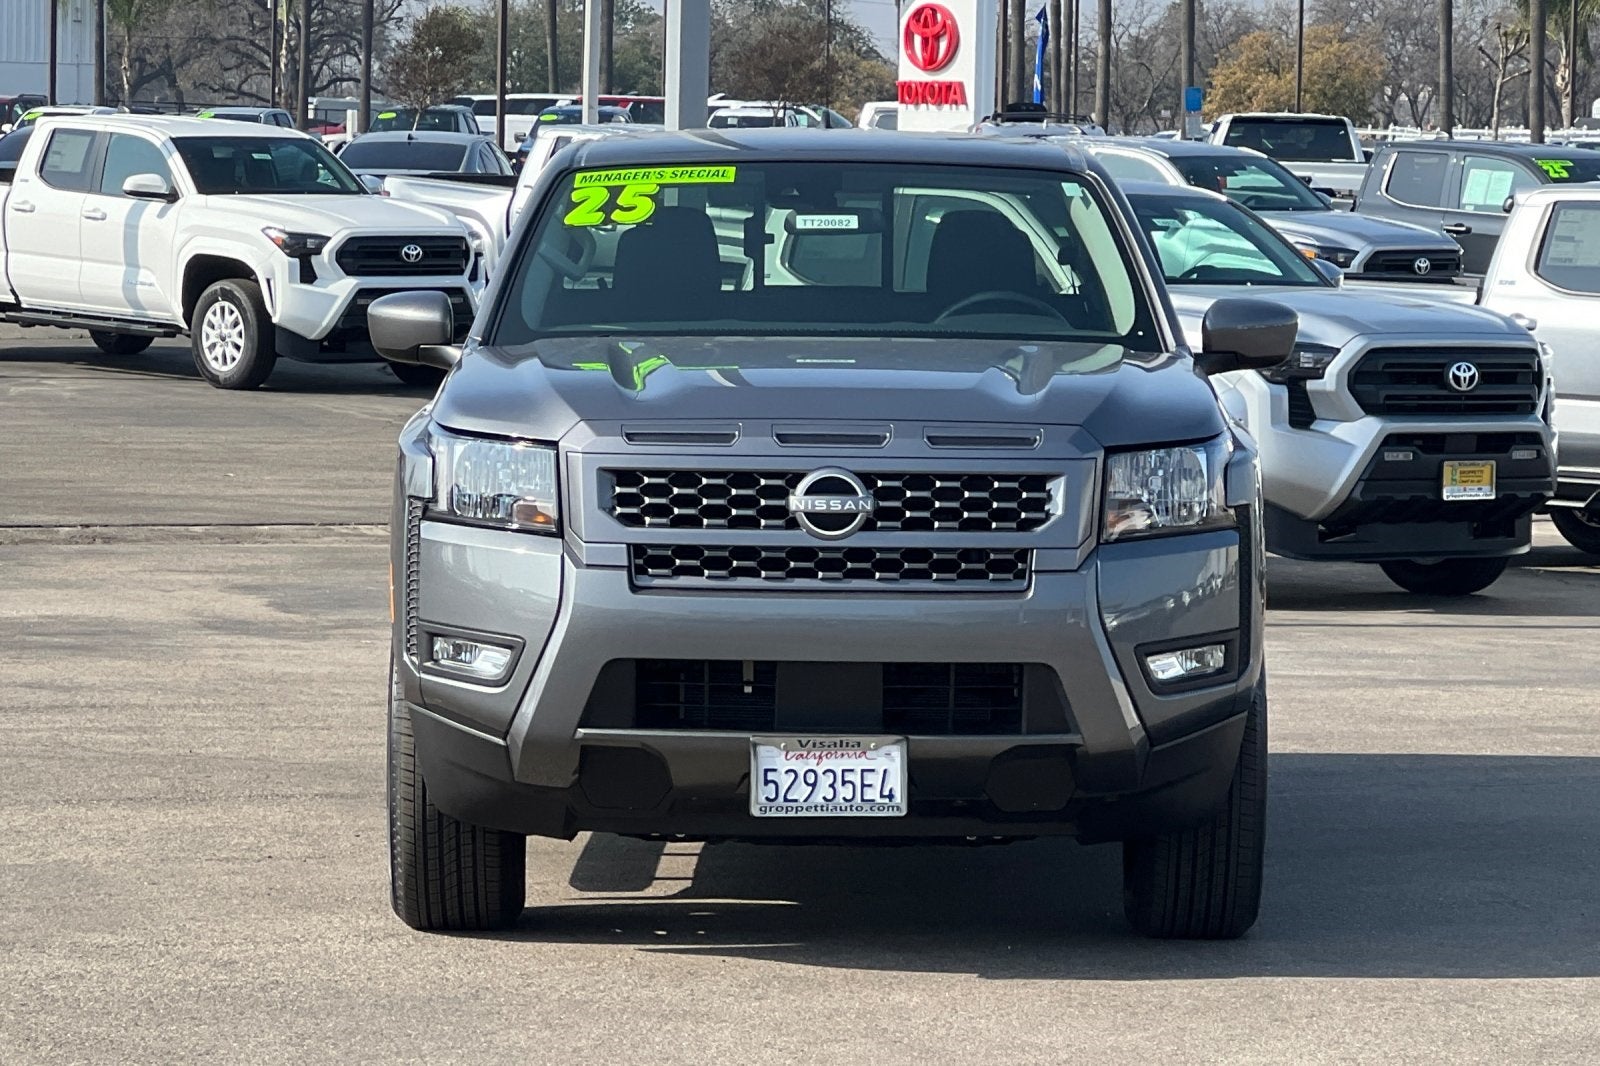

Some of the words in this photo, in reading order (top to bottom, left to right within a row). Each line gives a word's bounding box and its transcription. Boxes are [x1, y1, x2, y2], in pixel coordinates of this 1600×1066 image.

[896, 80, 968, 105] TOYOTA
[579, 170, 666, 184] MANAGER'S
[671, 168, 729, 179] SPECIAL
[563, 183, 660, 226] 25
[801, 218, 851, 227] TT20082
[792, 499, 871, 510] NISSAN
[797, 739, 861, 749] Visalia
[784, 749, 878, 766] California
[763, 768, 896, 803] 52935E4
[759, 803, 901, 815] groppettiauto.com
